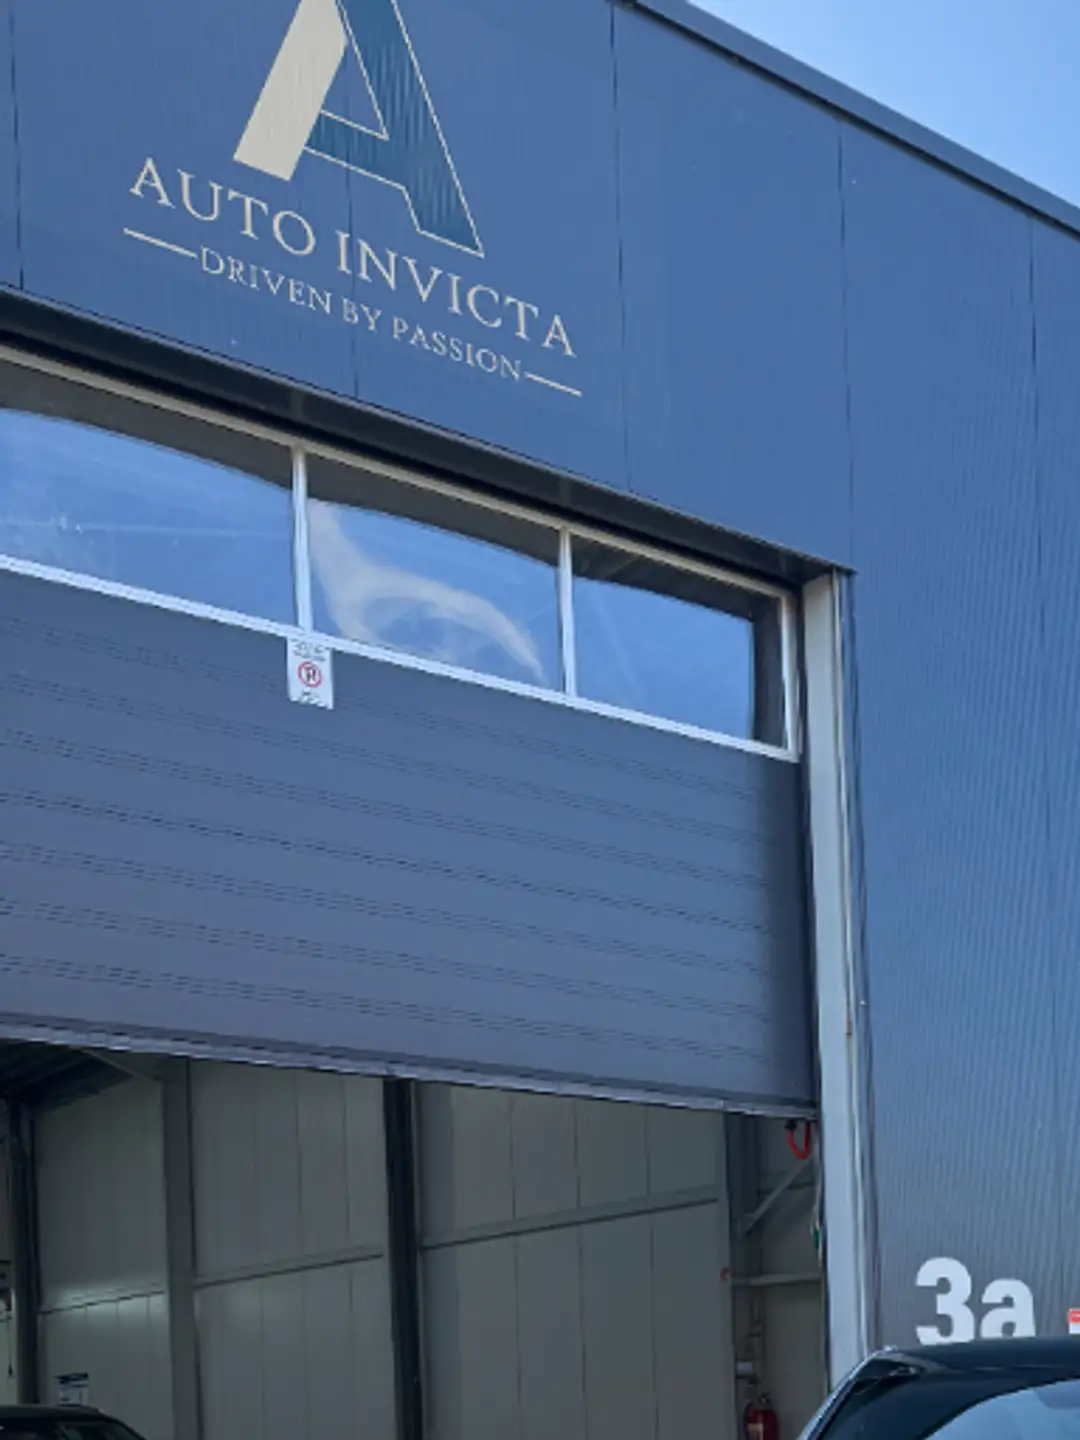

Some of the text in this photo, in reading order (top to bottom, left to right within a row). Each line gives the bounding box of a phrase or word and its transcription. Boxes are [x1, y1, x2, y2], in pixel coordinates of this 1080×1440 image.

[129, 157, 577, 358] AUTO INVICTA
[200, 245, 522, 381] DRIVEN BY PASSION
[916, 1257, 1036, 1346] 3a
